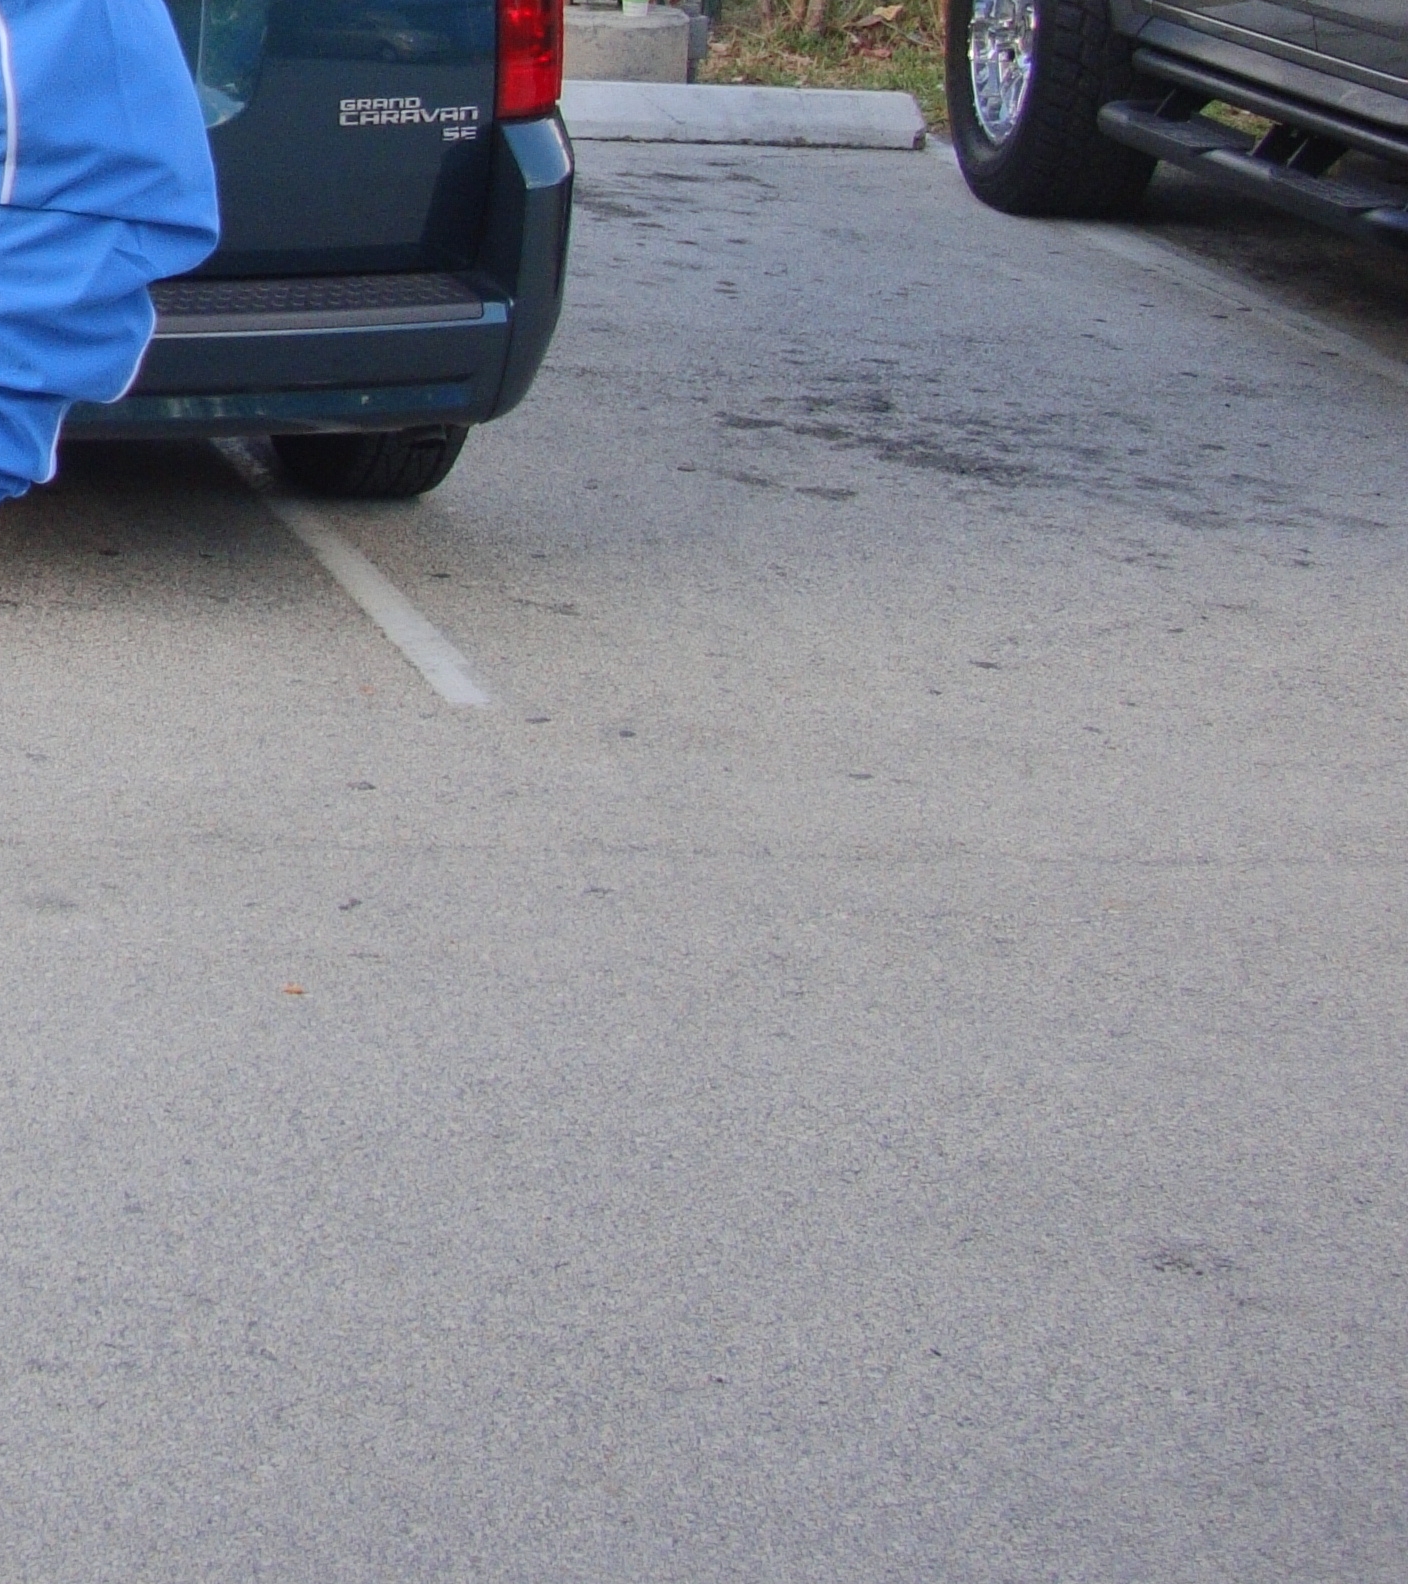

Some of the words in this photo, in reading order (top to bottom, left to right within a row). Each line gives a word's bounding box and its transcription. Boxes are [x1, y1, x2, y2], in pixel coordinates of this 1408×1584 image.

[339, 97, 421, 111] GRAND
[339, 106, 478, 126] CARAVAN
[442, 126, 478, 141] SE
